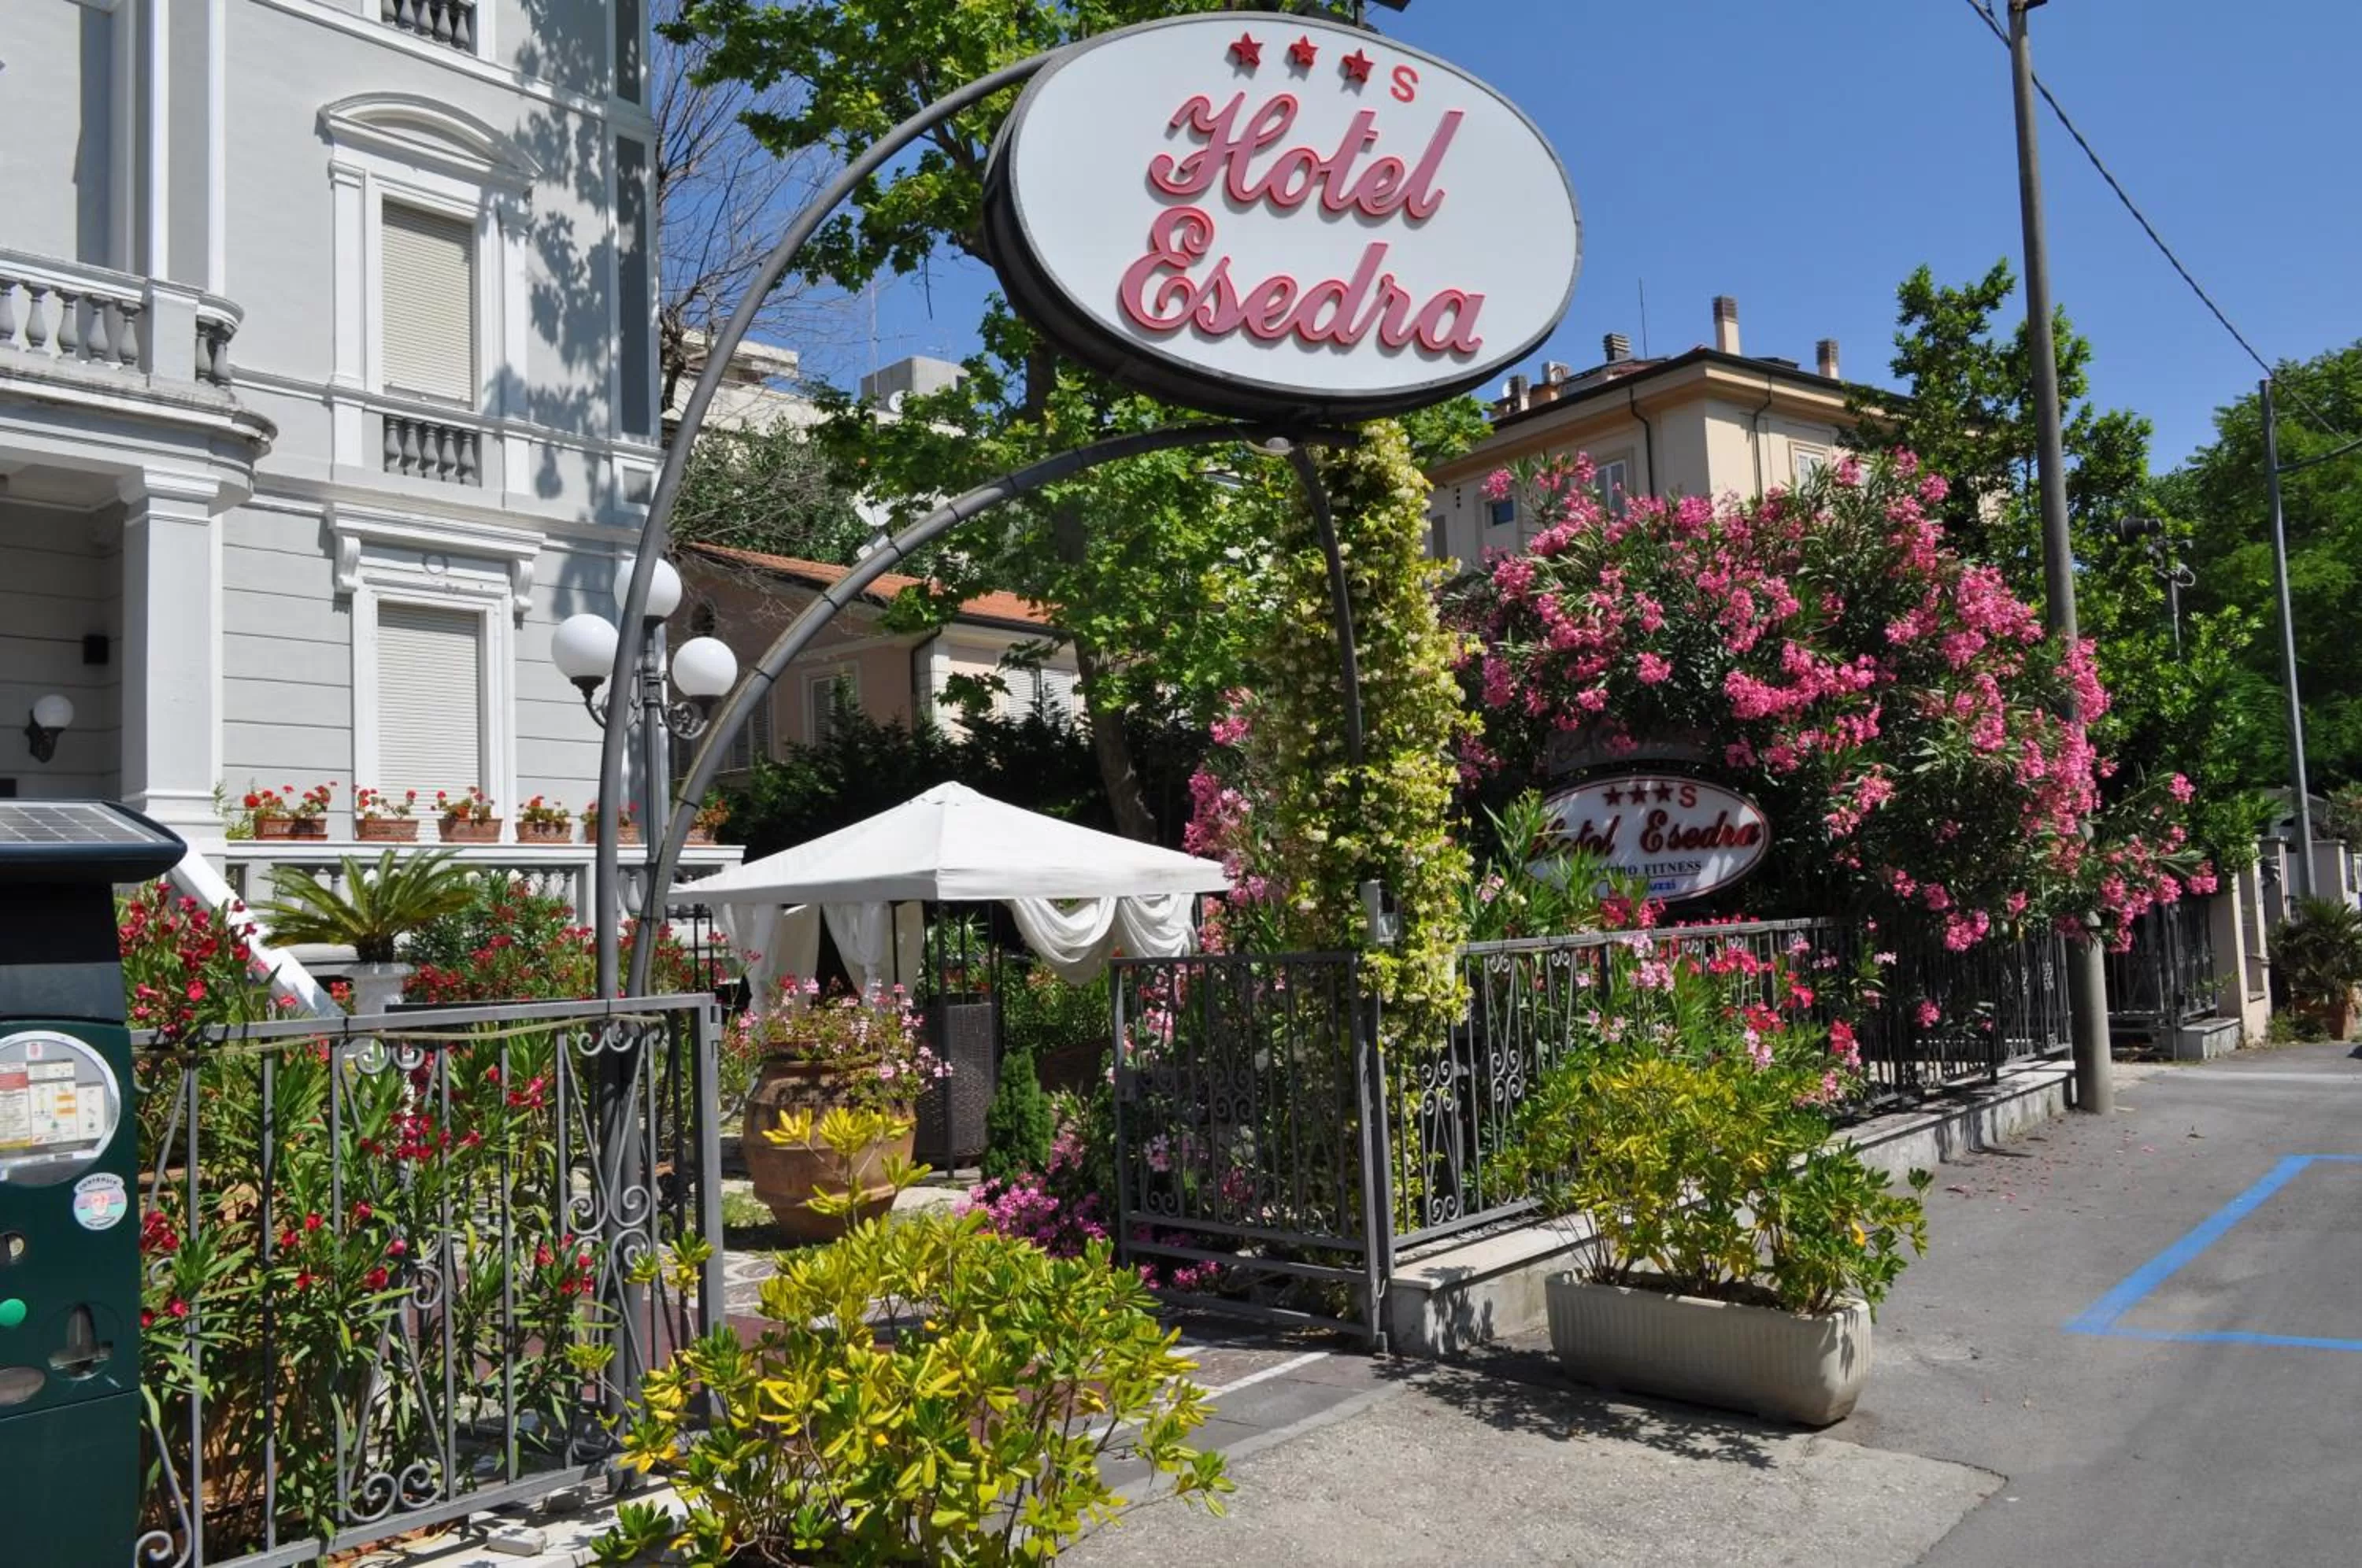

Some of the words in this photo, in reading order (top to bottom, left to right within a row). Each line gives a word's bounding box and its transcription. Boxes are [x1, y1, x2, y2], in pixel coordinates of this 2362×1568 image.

[1390, 65, 1419, 103] S
[1150, 91, 1464, 220] Hotel
[1120, 206, 1486, 353] Esedra
[1679, 786, 1697, 808] S
[1639, 809, 1761, 853] Esedra
[1644, 860, 1701, 875] FITNESS
